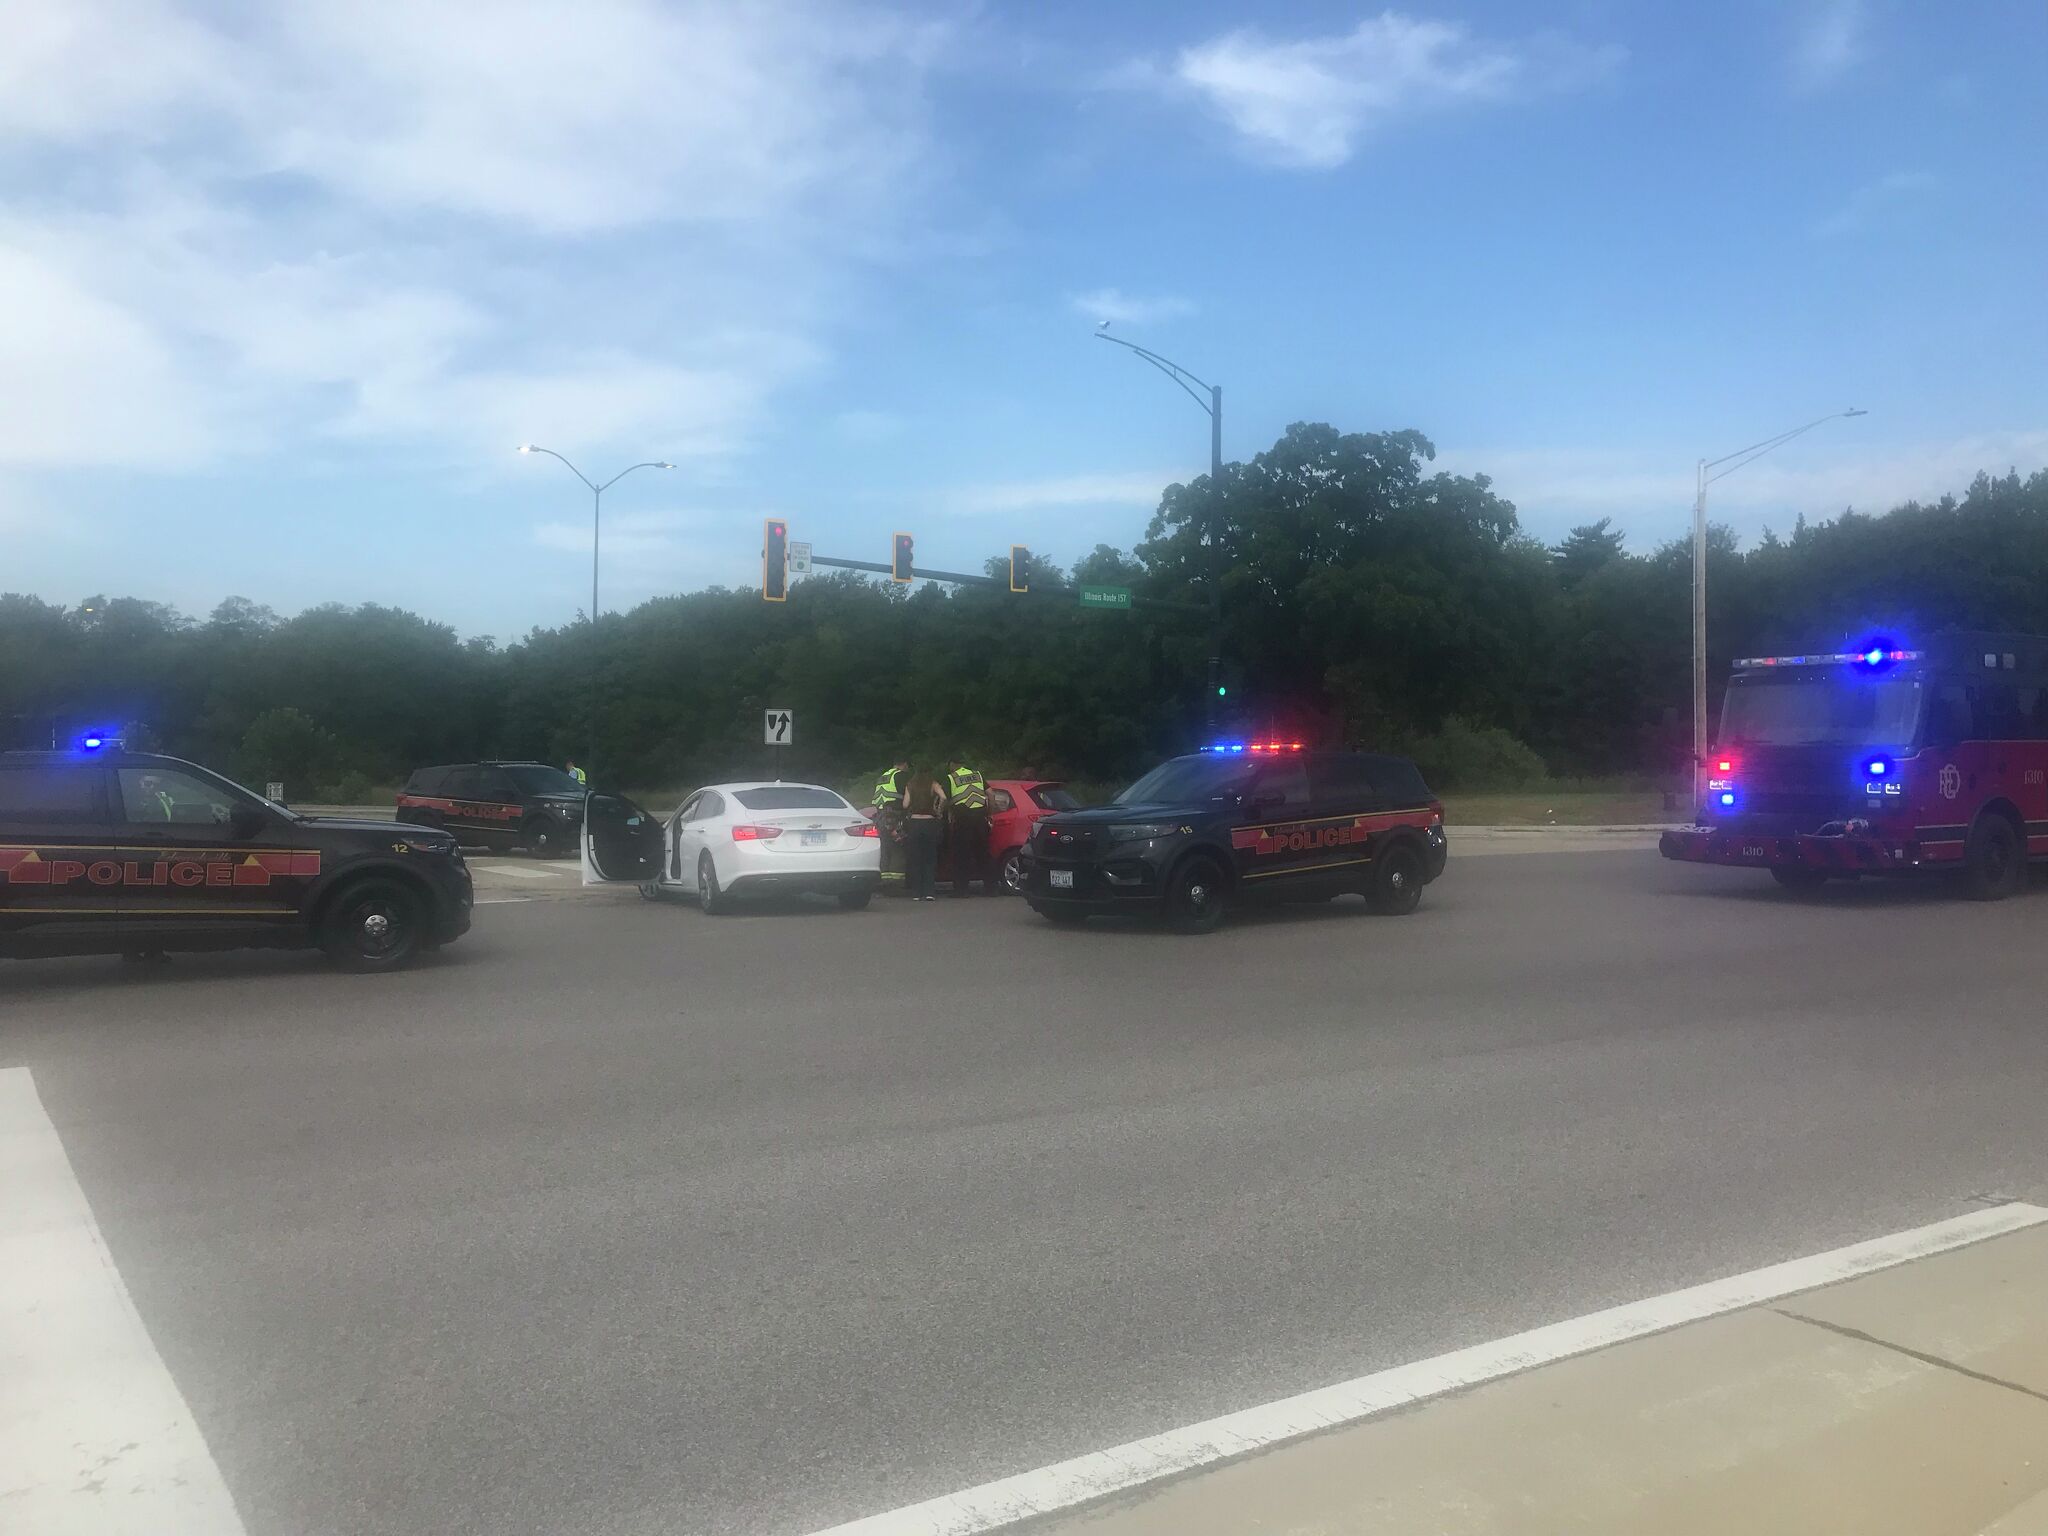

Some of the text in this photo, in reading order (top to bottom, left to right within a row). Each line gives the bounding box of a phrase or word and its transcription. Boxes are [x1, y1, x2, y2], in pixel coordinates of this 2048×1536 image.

[1084, 592, 1127, 603] Illinois Route 157
[2023, 769, 2044, 785] 1310
[457, 804, 501, 820] POLICE
[1179, 825, 1193, 835] 15
[1273, 826, 1351, 854] POLICE
[391, 843, 409, 853] 12
[1742, 846, 1764, 857] 1310
[51, 860, 234, 886] POLICE
